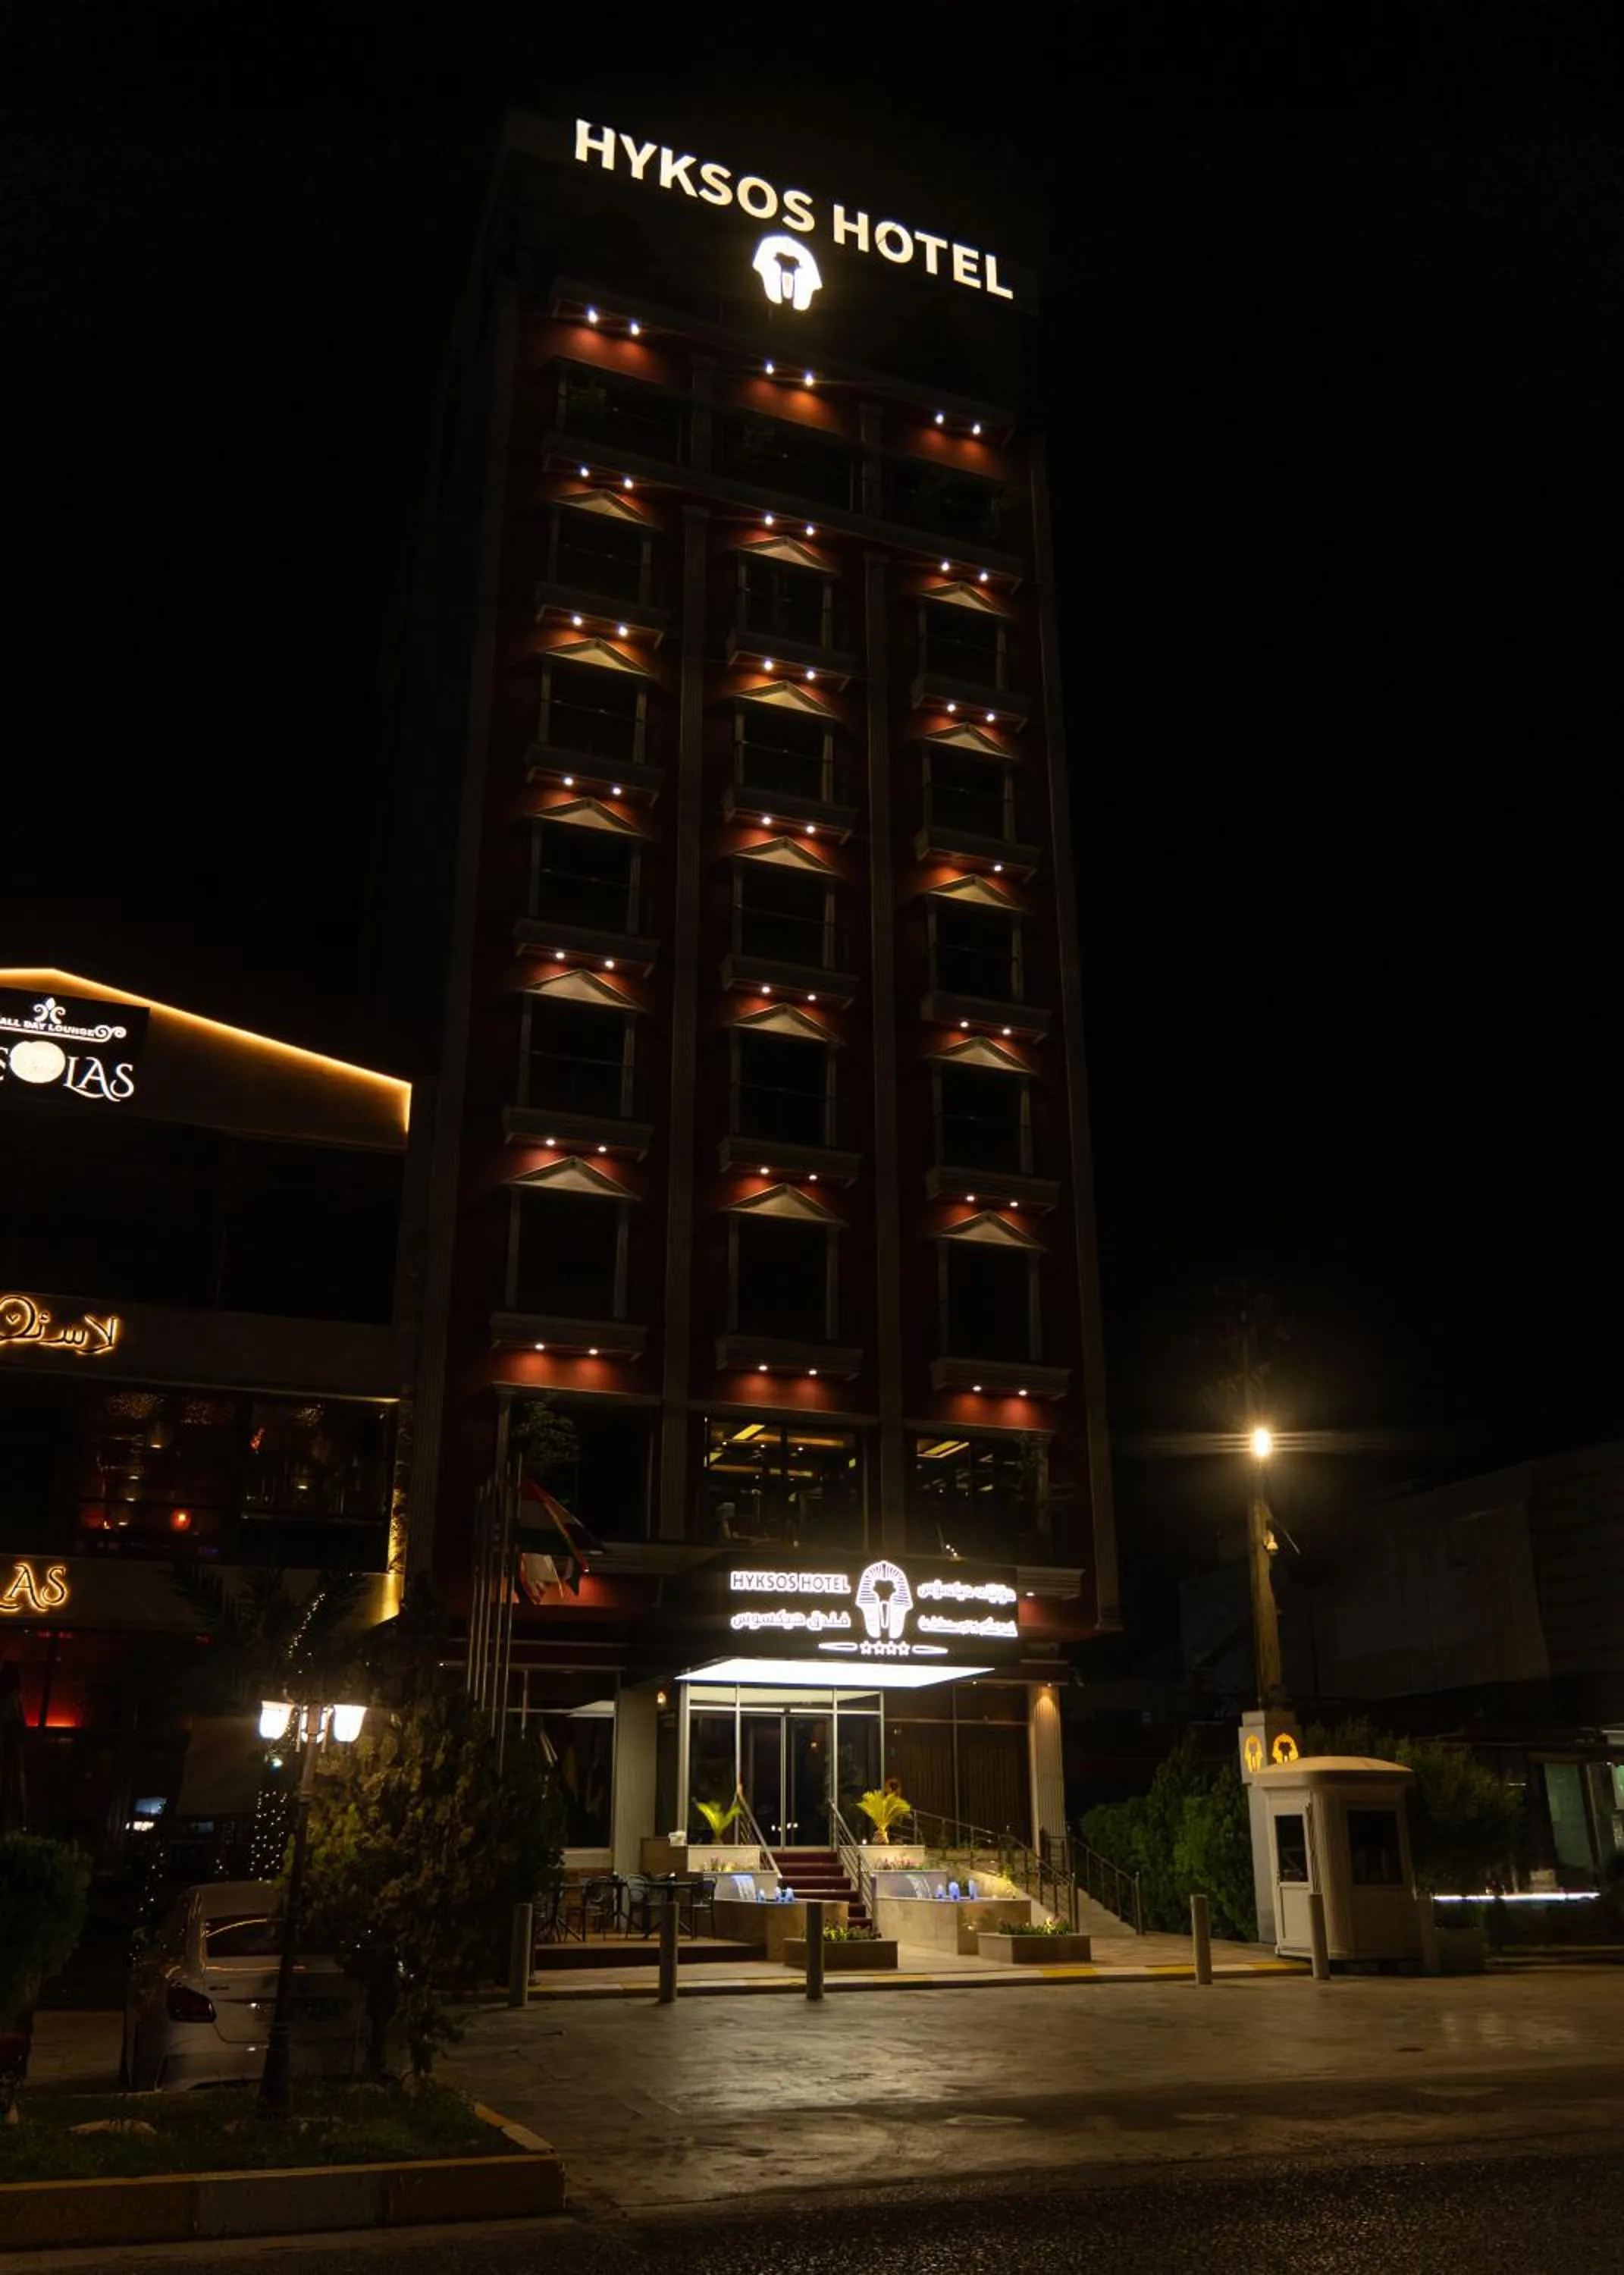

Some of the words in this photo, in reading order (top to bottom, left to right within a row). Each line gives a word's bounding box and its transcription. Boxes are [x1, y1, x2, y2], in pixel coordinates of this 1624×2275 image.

[575, 118, 816, 233] HYKSOS
[832, 204, 1014, 300] HOTEL
[24, 1020, 46, 1031] DAY
[48, 1023, 95, 1037] LOUNGE
[731, 1571, 798, 1590] HYKSOS
[799, 1574, 851, 1593] HOTEL
[807, 1610, 851, 1630] فندق
